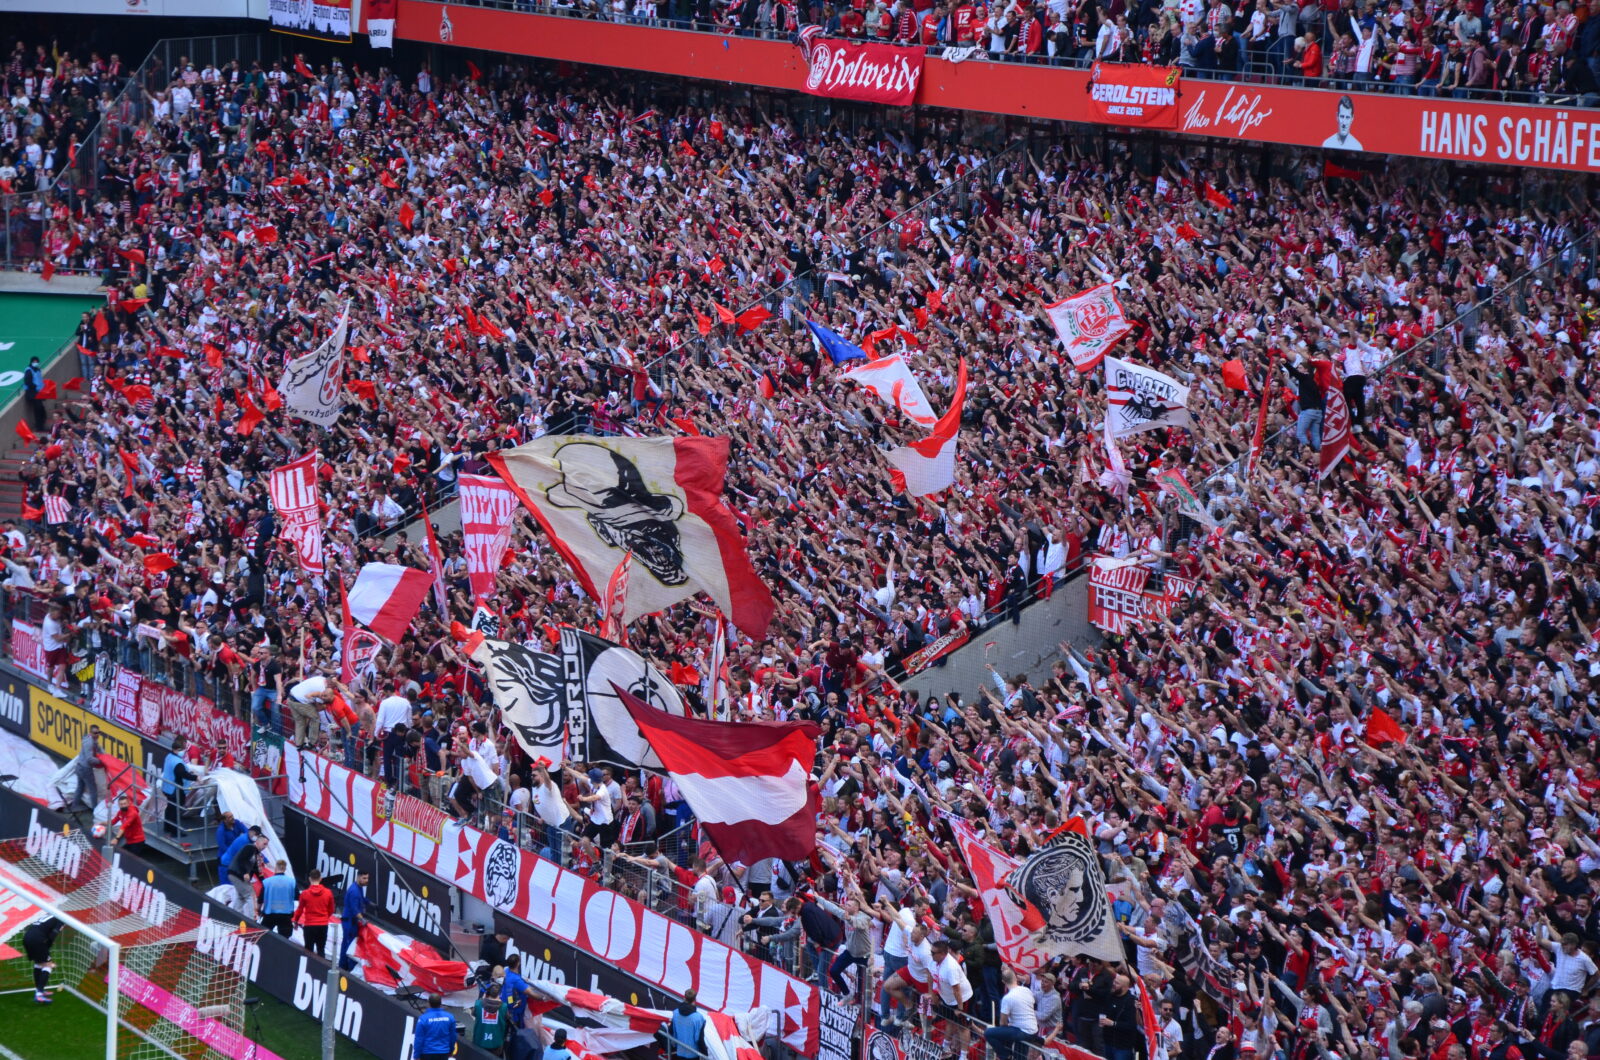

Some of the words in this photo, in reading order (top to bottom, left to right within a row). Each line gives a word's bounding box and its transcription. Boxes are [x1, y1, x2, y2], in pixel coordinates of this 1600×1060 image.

[825, 48, 920, 93] Holweide
[1092, 83, 1175, 106] GEROLSTEIN
[1421, 110, 1488, 157] HANS
[1497, 112, 1600, 167] SCHÄFE
[25, 808, 81, 879] bwin
[1228, 833, 1239, 851] 9
[110, 853, 167, 927] bwin
[386, 871, 442, 936] bwin
[197, 902, 260, 982] bwin
